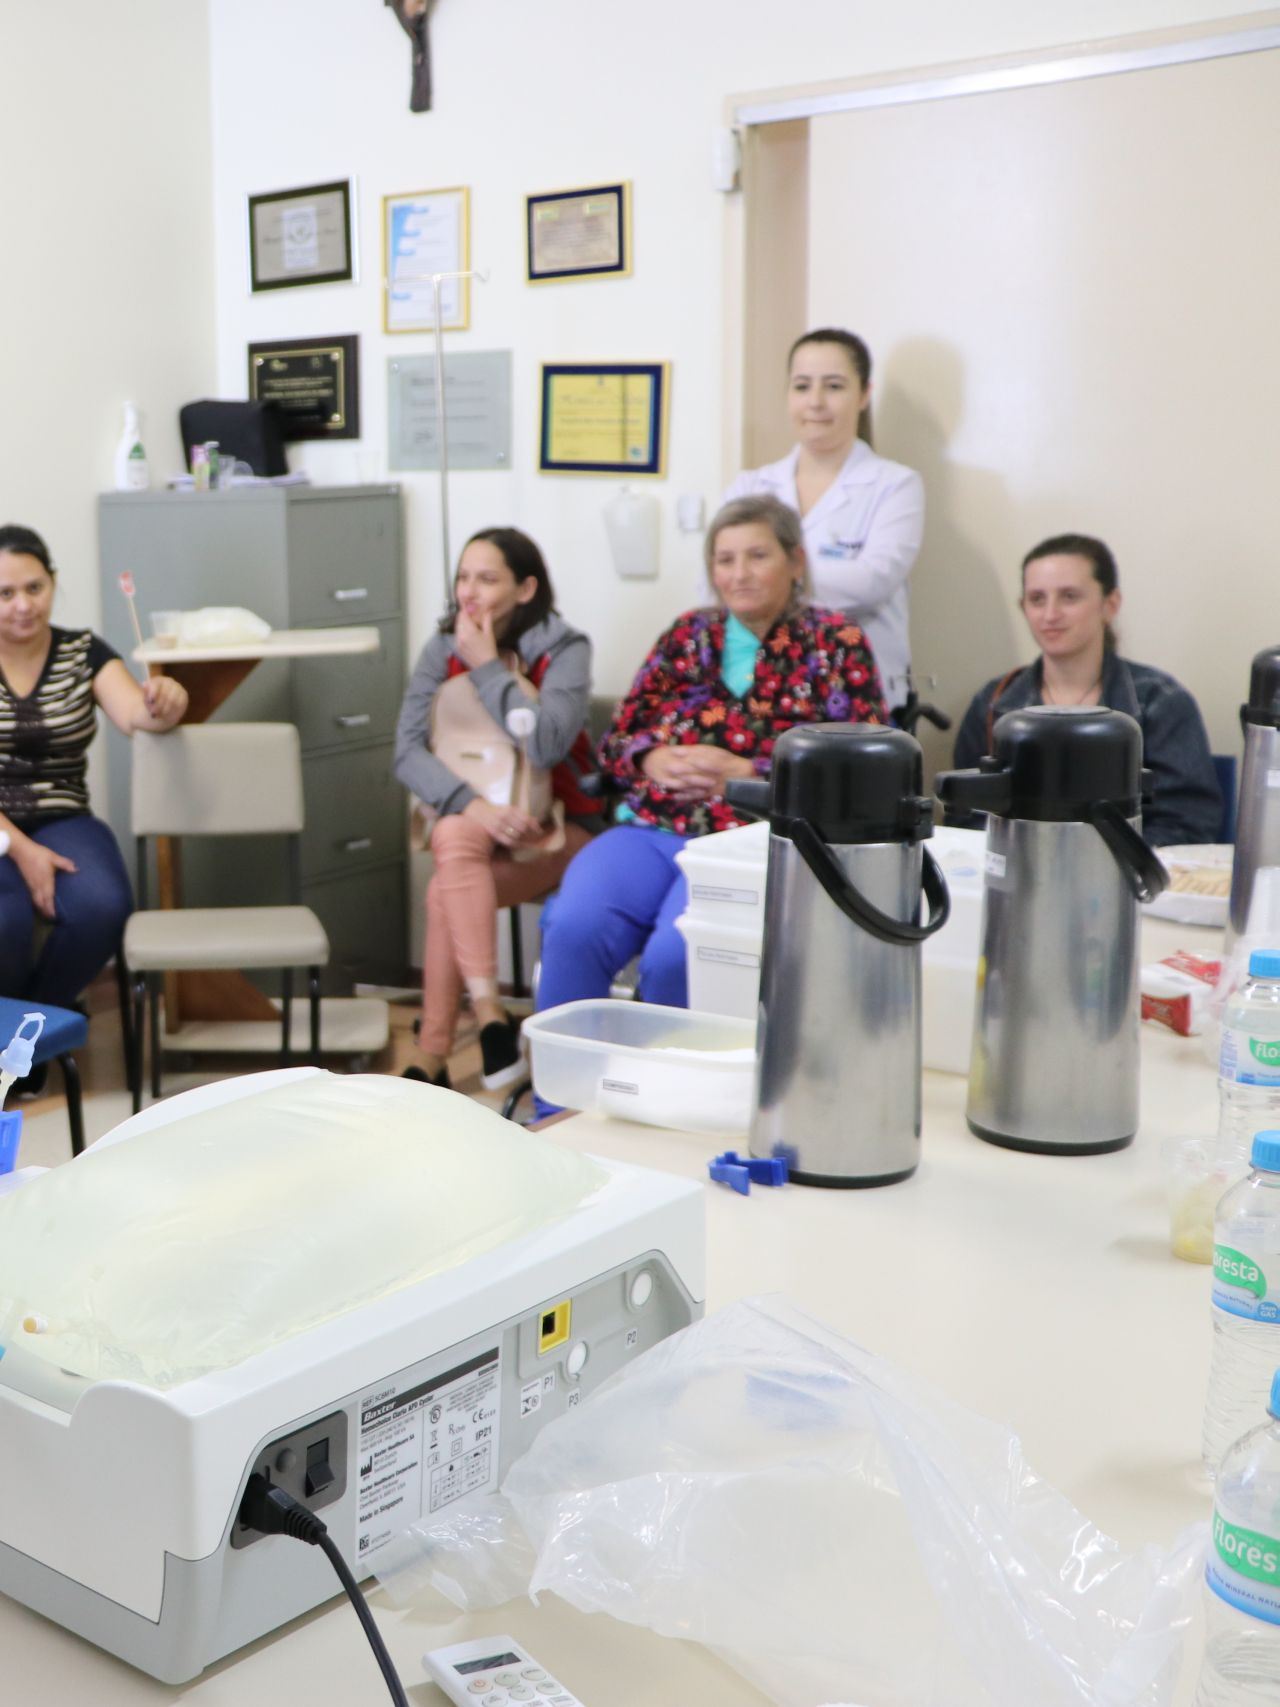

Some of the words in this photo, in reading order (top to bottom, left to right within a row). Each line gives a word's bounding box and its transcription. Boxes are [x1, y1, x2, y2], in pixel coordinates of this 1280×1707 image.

[626, 1331, 637, 1345] P2
[544, 1375, 554, 1390] P1
[569, 1392, 579, 1408] P3
[363, 1401, 397, 1423] Baxter
[475, 1425, 492, 1441] IP21
[1215, 1517, 1278, 1574] flores
